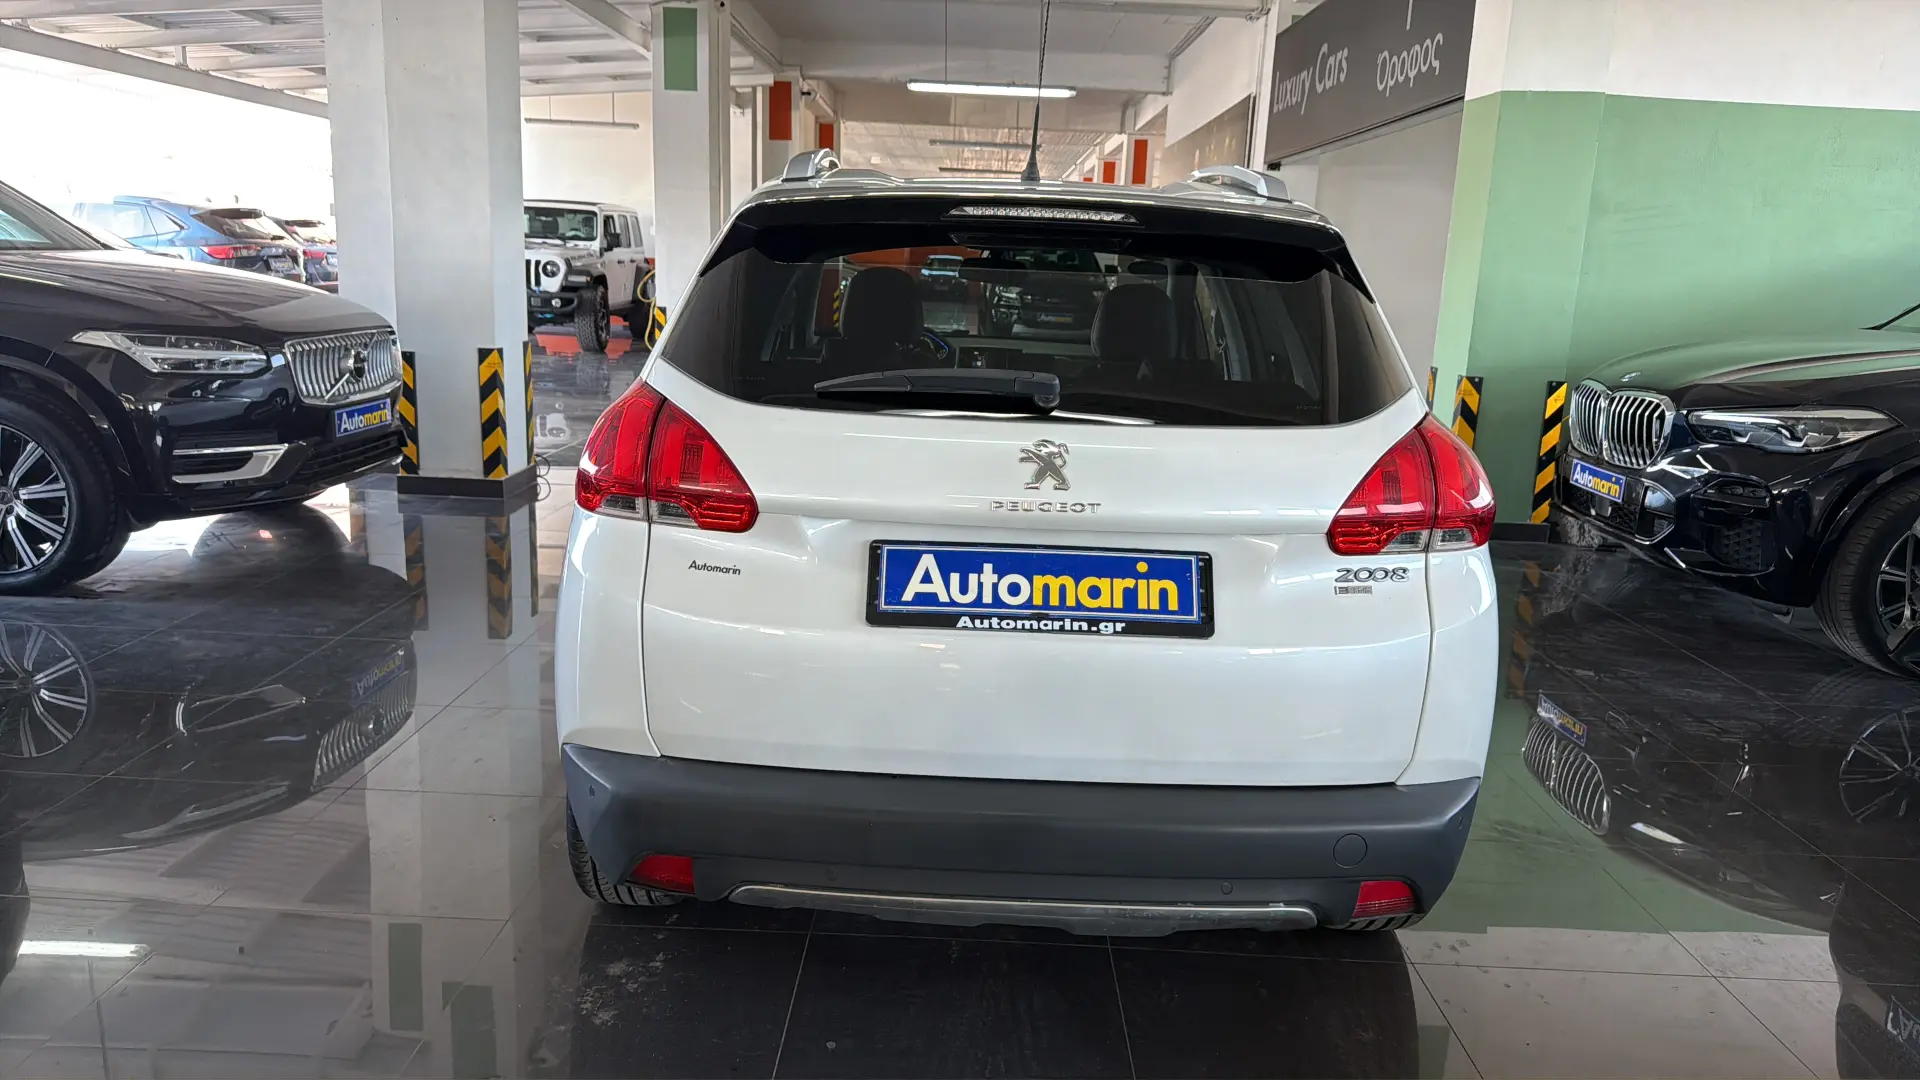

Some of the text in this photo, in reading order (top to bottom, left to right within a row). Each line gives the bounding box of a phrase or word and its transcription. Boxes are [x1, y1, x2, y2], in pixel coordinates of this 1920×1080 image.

[1273, 42, 1349, 115] Luxury Cars
[1376, 32, 1443, 97] Όροφος
[340, 403, 389, 433] Automarin
[1573, 463, 1620, 498] Automarin
[990, 501, 1102, 513] PEUGEOT
[688, 559, 741, 576] Automarin
[901, 553, 1178, 611] Automarin
[1334, 566, 1410, 583] 2008
[956, 615, 1126, 634] Automarin.gr
